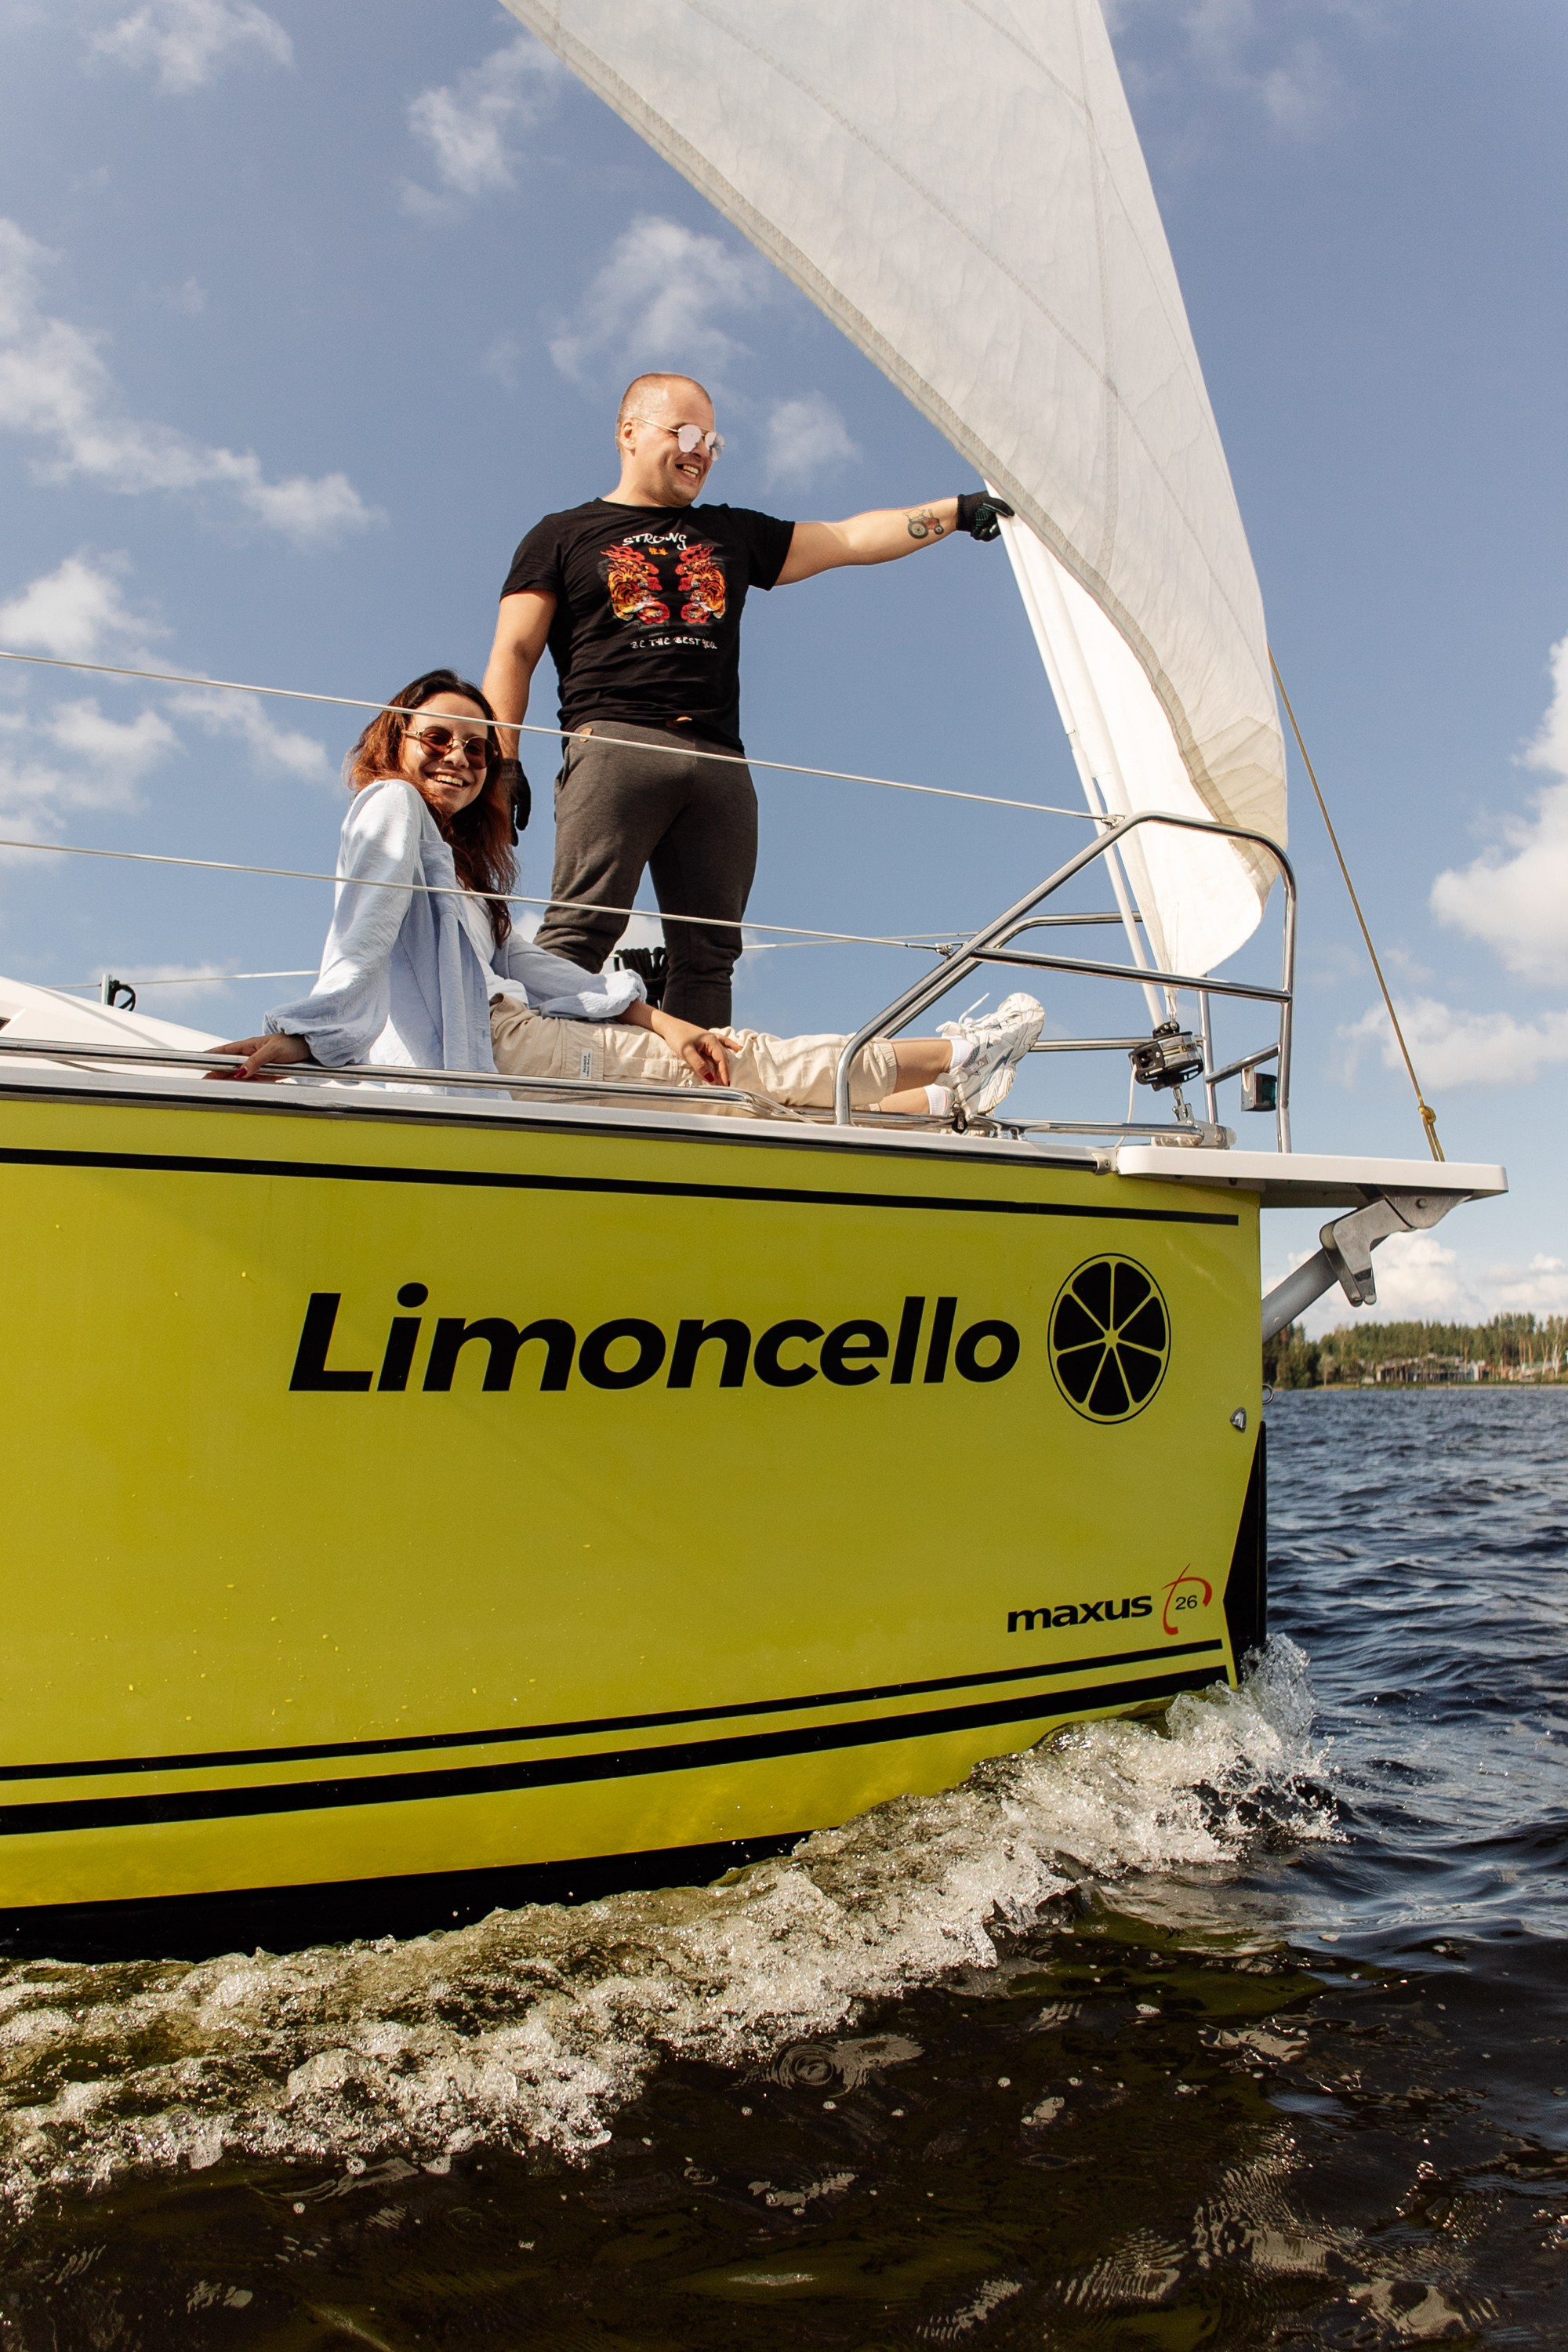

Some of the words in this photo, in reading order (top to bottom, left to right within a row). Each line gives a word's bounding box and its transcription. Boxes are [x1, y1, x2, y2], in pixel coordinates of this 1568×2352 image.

[622, 532, 687, 550] STRONG
[630, 640, 646, 649] BE
[649, 637, 670, 647] THE
[673, 636, 701, 645] BEST
[289, 1282, 1022, 1392] Limoncello
[1007, 1595, 1153, 1633] maxus
[1174, 1595, 1198, 1610] 26
